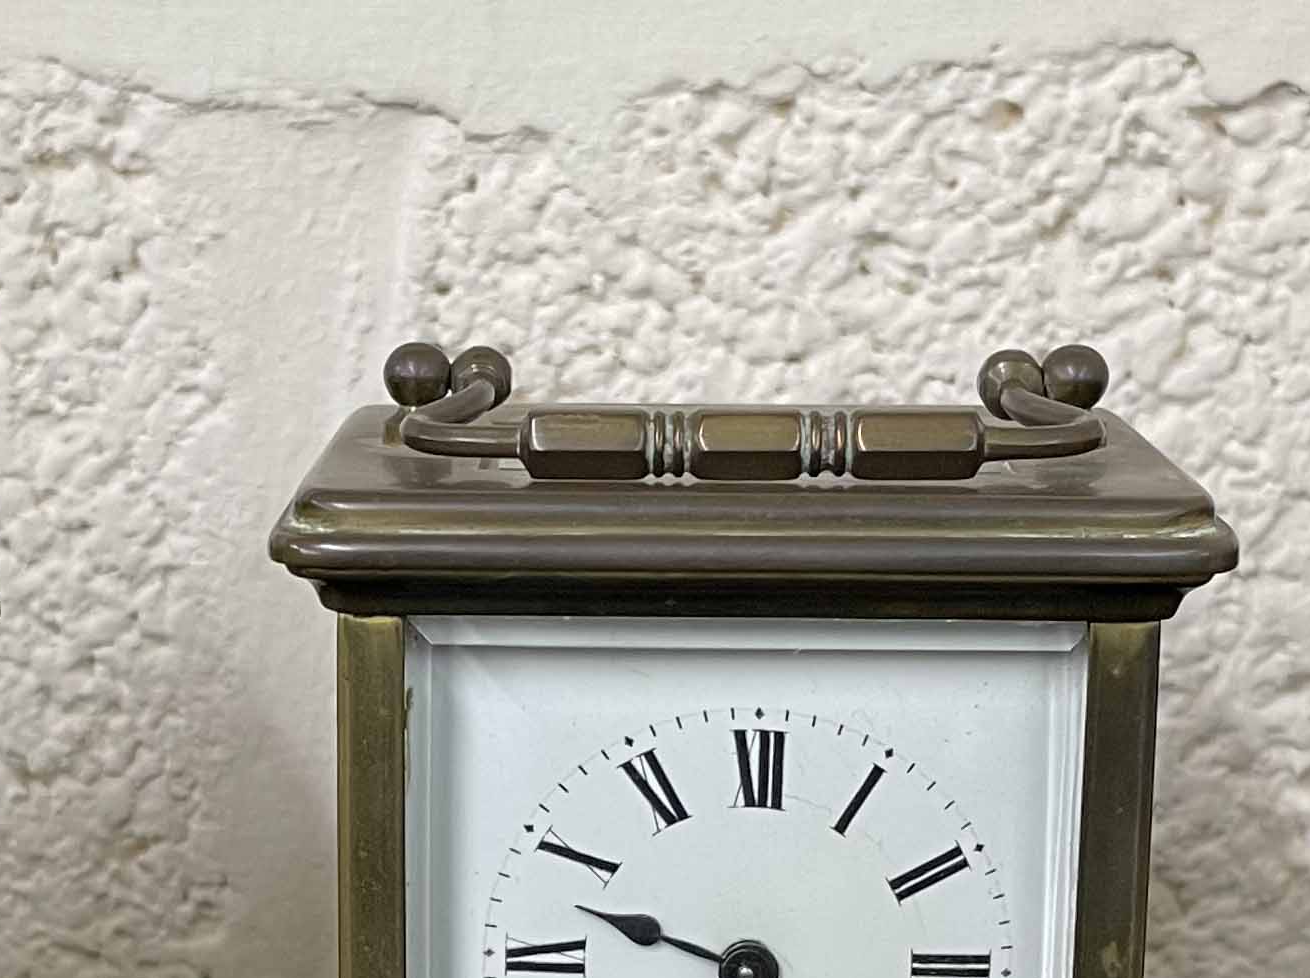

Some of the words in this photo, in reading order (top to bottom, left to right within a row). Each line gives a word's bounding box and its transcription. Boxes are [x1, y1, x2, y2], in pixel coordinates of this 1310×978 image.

[617, 748, 694, 836] XI
[729, 728, 788, 811] XII
[830, 763, 888, 837] I
[535, 826, 623, 888] X
[886, 840, 972, 904] II
[505, 932, 587, 977] IX
